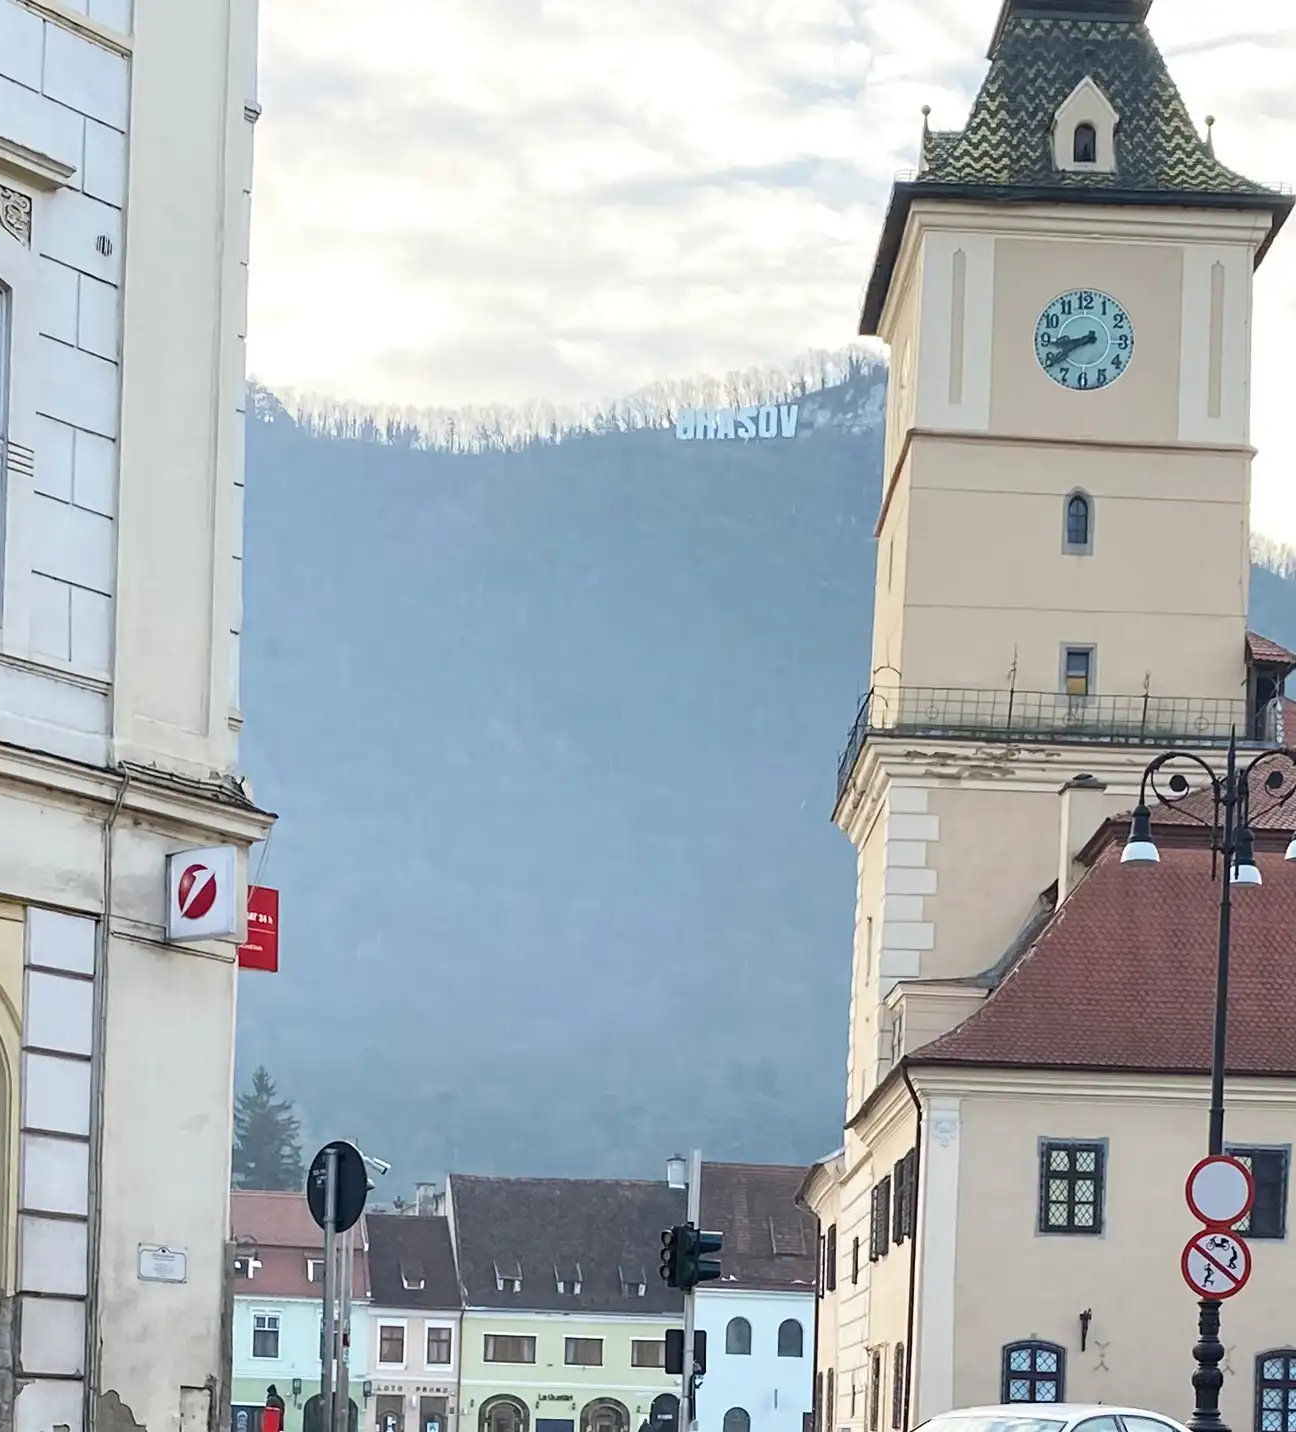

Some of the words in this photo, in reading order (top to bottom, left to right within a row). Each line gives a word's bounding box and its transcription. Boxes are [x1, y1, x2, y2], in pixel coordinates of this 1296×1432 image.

[1060, 300, 1072, 315] 11
[1077, 292, 1094, 310] 12
[1045, 313, 1059, 328] 10
[1113, 313, 1124, 329] 2
[1040, 332, 1051, 347] 9
[1118, 334, 1128, 349] 3
[1111, 354, 1122, 369] 4
[1060, 367, 1070, 382] 7
[1077, 372, 1087, 388] 6
[1097, 369, 1107, 384] 5
